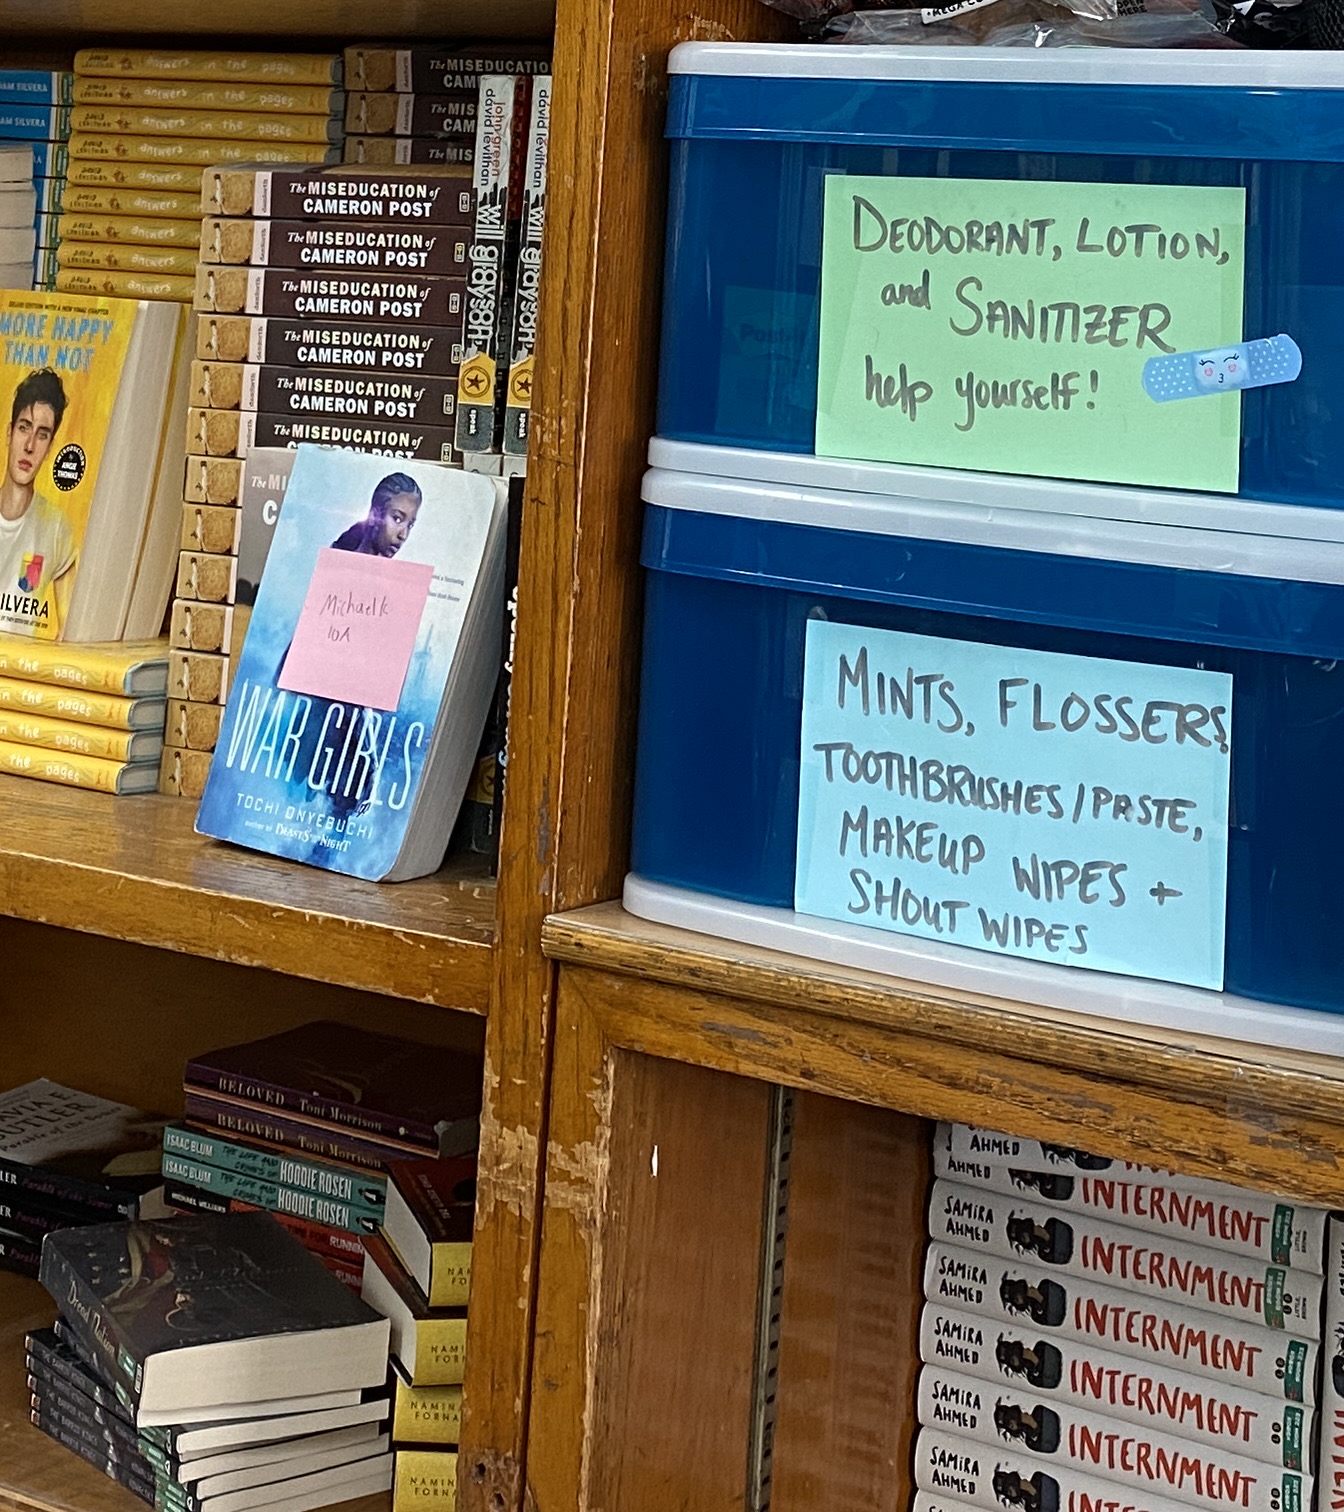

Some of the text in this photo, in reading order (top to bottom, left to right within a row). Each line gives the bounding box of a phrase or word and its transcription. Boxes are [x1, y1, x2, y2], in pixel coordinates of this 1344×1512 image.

[289, 182, 440, 201] The MISEDUCATION of
[303, 199, 432, 218] CAMERON POST
[853, 195, 1230, 266] DEODORANT, LOTION,
[881, 269, 1176, 354] and SANITIZER
[864, 354, 1099, 431] help yourself!
[838, 646, 976, 738] MINTS,
[226, 679, 425, 811] WAR GIRLS
[237, 792, 373, 839] TOCHI ONYEBUCHI
[839, 805, 1183, 907] MAKEUP WIPES +
[848, 868, 1089, 955] SHOUT WIPES
[280, 1161, 353, 1201] HOODIE ROSEN
[945, 1220, 991, 1243] AHMED
[1081, 1235, 1267, 1314] INTERNMENT
